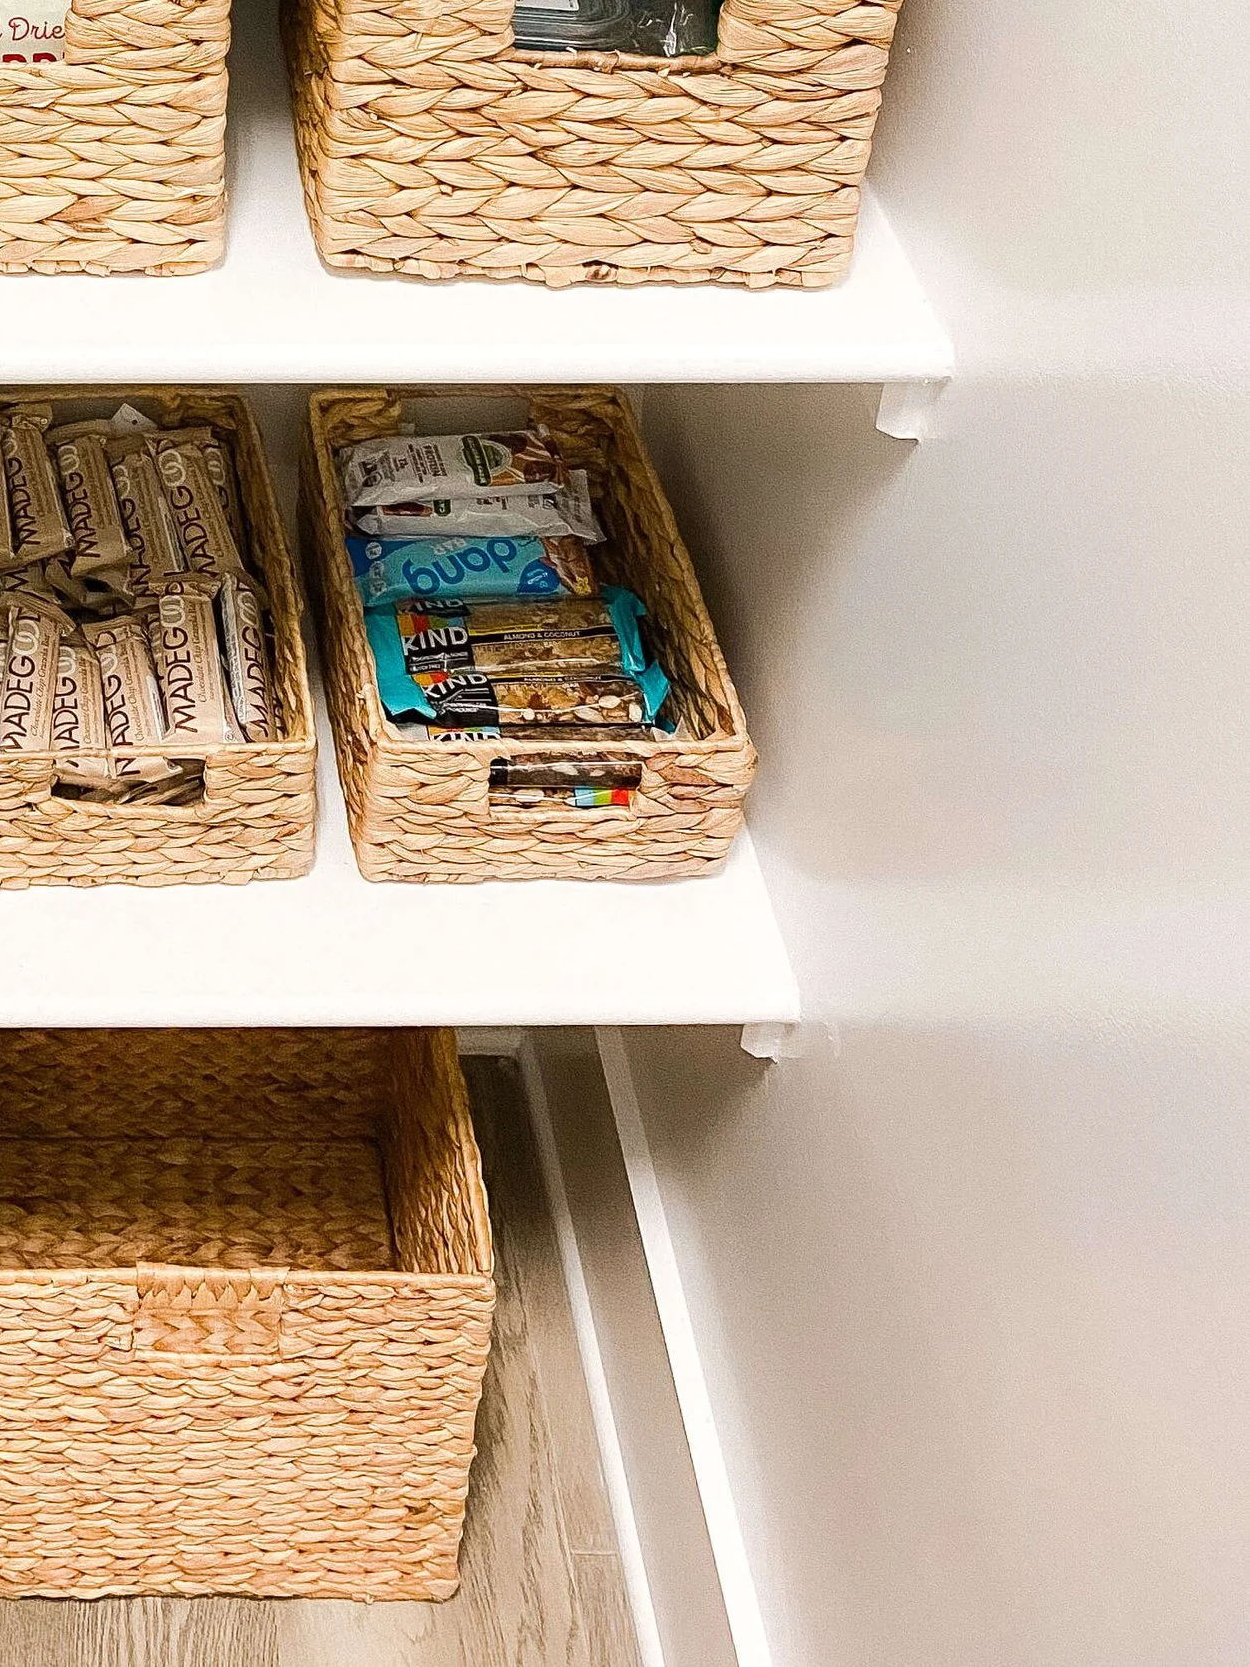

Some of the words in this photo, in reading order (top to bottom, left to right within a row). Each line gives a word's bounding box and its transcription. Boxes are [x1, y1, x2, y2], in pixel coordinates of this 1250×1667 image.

[401, 538, 517, 596] dang
[401, 626, 469, 656] KIND
[503, 631, 536, 641] ALMOND
[543, 630, 581, 639] COCONUT
[159, 581, 199, 733] MADEGOOD
[421, 673, 489, 699] KIND
